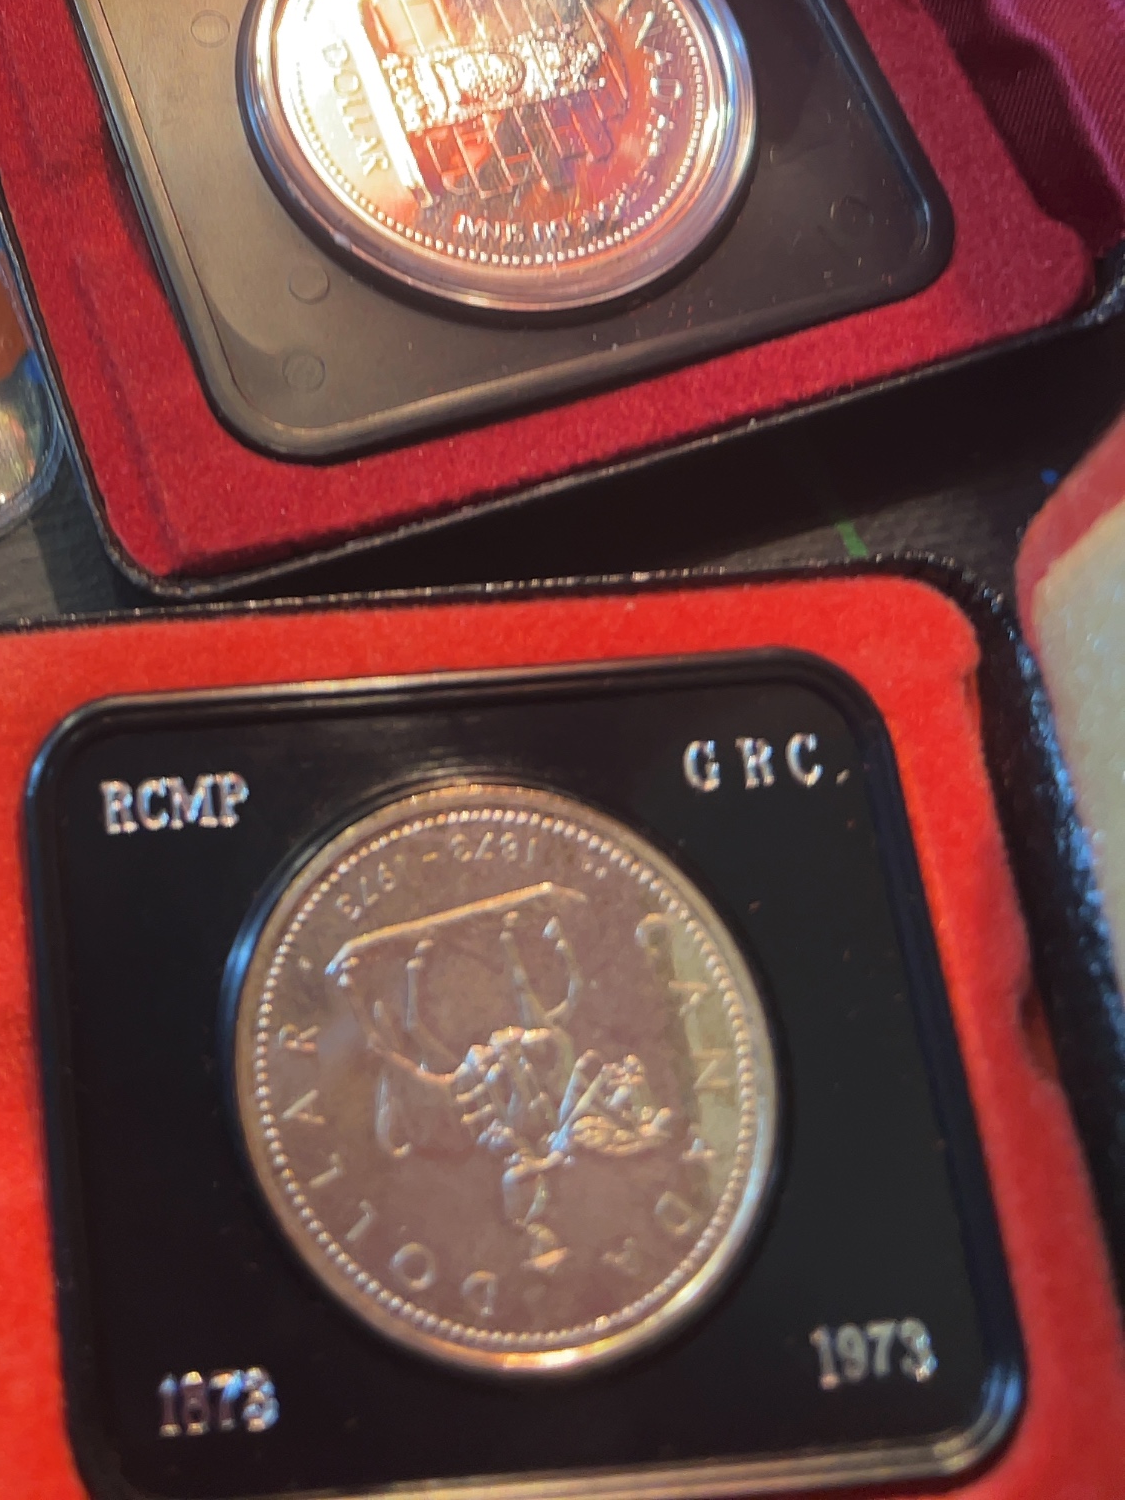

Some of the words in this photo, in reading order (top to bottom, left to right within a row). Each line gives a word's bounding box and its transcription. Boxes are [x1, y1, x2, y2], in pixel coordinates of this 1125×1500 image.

[319, 41, 392, 176] DOLLAR
[99, 771, 250, 835] RCMP
[277, 1023, 499, 1318] DOLLAR
[808, 1317, 939, 1390] 1973
[158, 1367, 280, 1439] 1873
